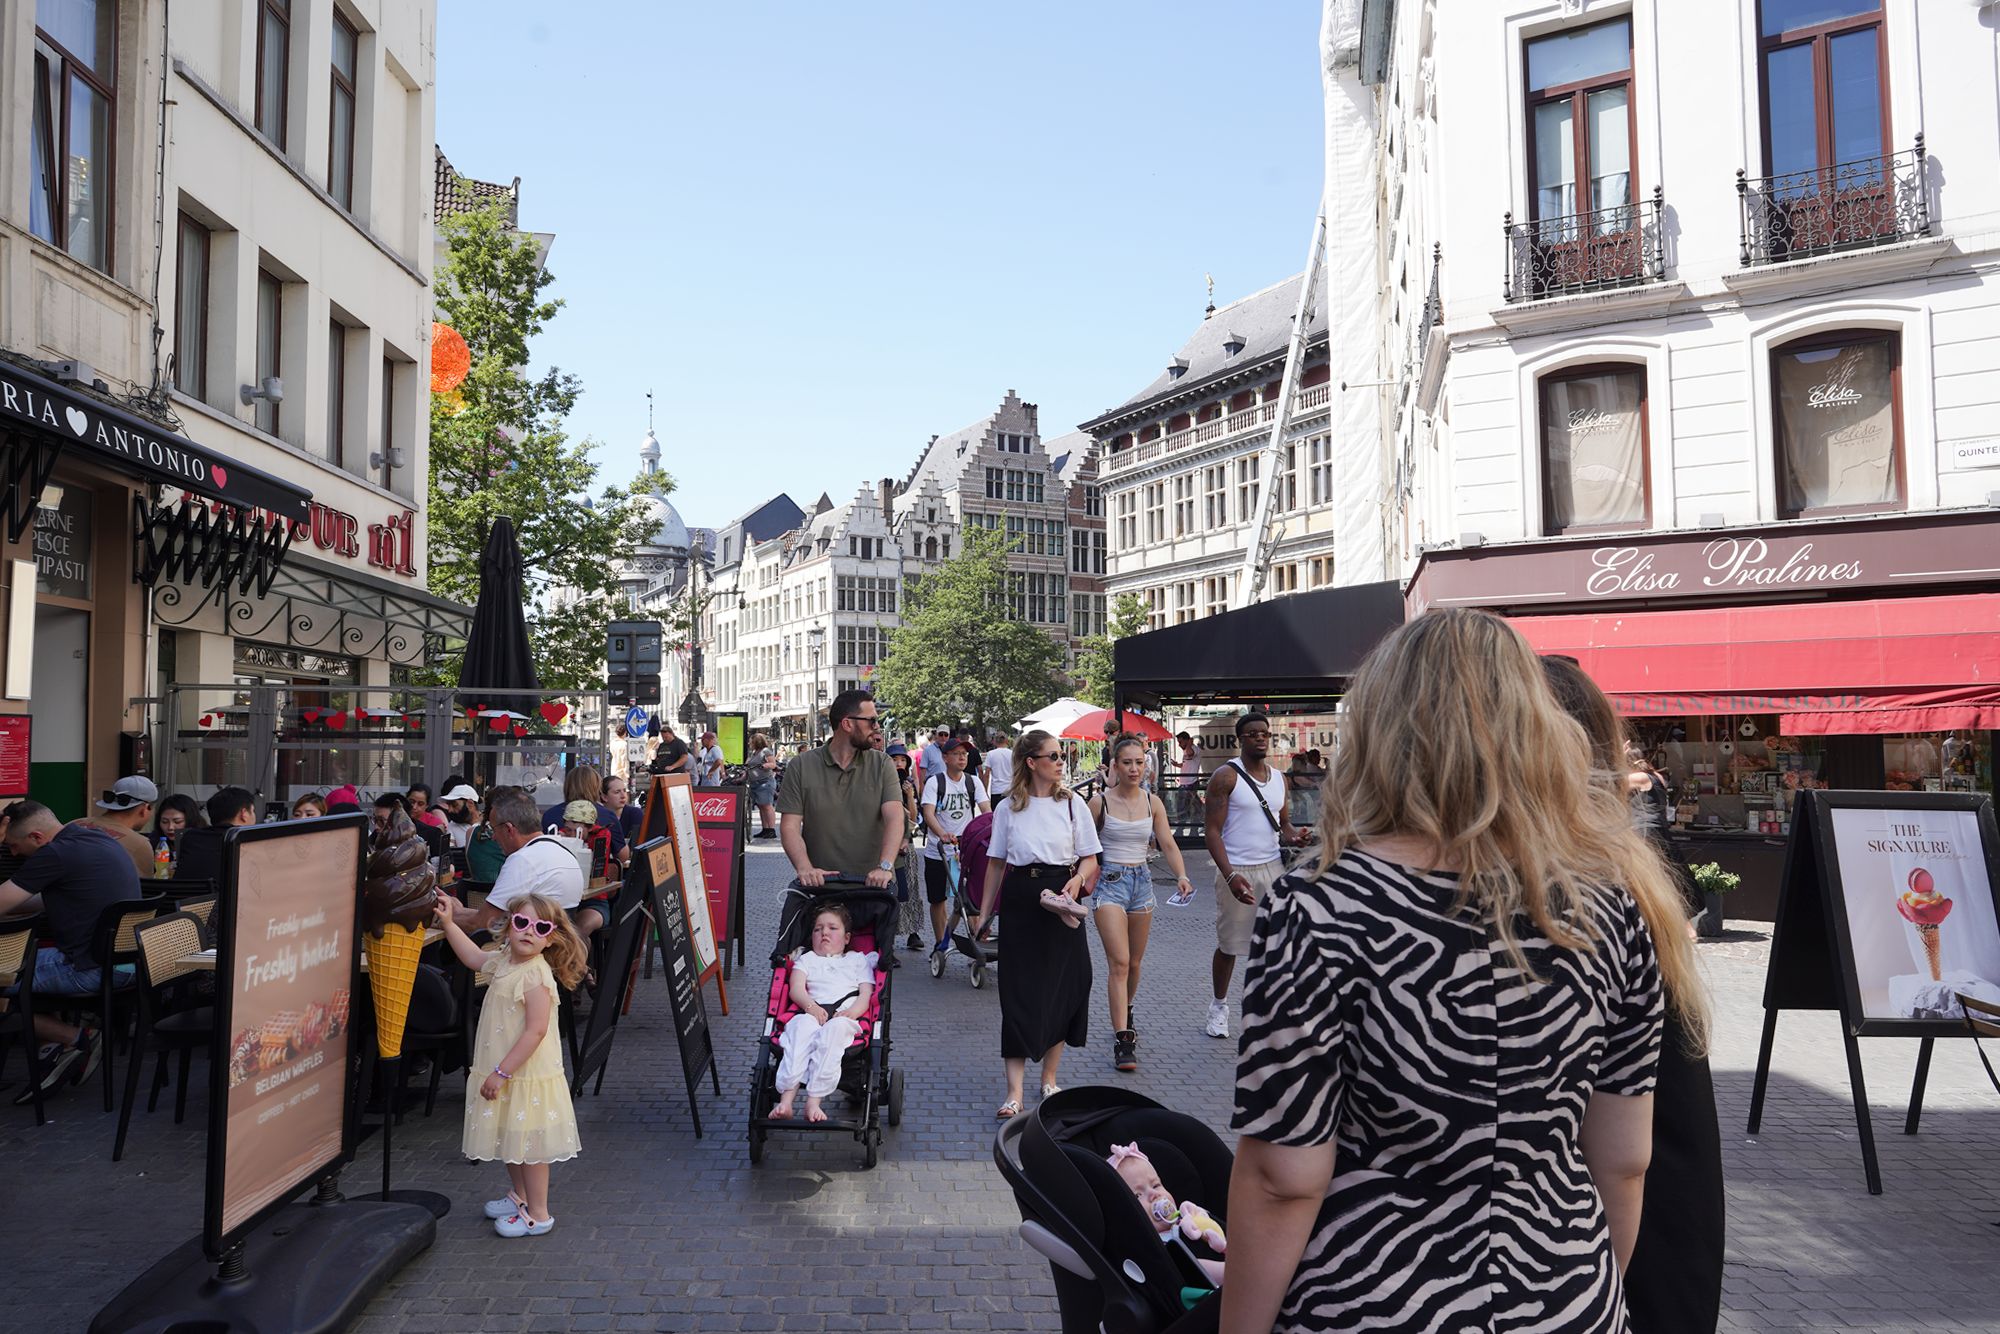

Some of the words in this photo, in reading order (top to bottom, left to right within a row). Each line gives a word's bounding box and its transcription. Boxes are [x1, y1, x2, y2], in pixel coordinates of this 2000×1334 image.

[1807, 384, 1863, 405] Elisa
[1813, 400, 1858, 408] PRALINES
[96, 420, 205, 482] ANTONIO
[1958, 446, 2000, 457] QUINTE
[34, 508, 74, 534] ARNE
[33, 553, 84, 581] TIPASTI
[1587, 547, 1681, 595] Elisa
[1702, 536, 1864, 586] Pralines
[1612, 696, 1704, 712] ELGIAN
[1310, 731, 1338, 748] LU
[942, 792, 971, 811] JETS
[1891, 824, 1922, 837] THE
[1867, 840, 1951, 854] SIGNATURE
[244, 944, 299, 993] Freshly
[301, 928, 340, 972] baked.
[255, 1067, 291, 1096] BELGIAN
[291, 1050, 324, 1078] WAFFLES
